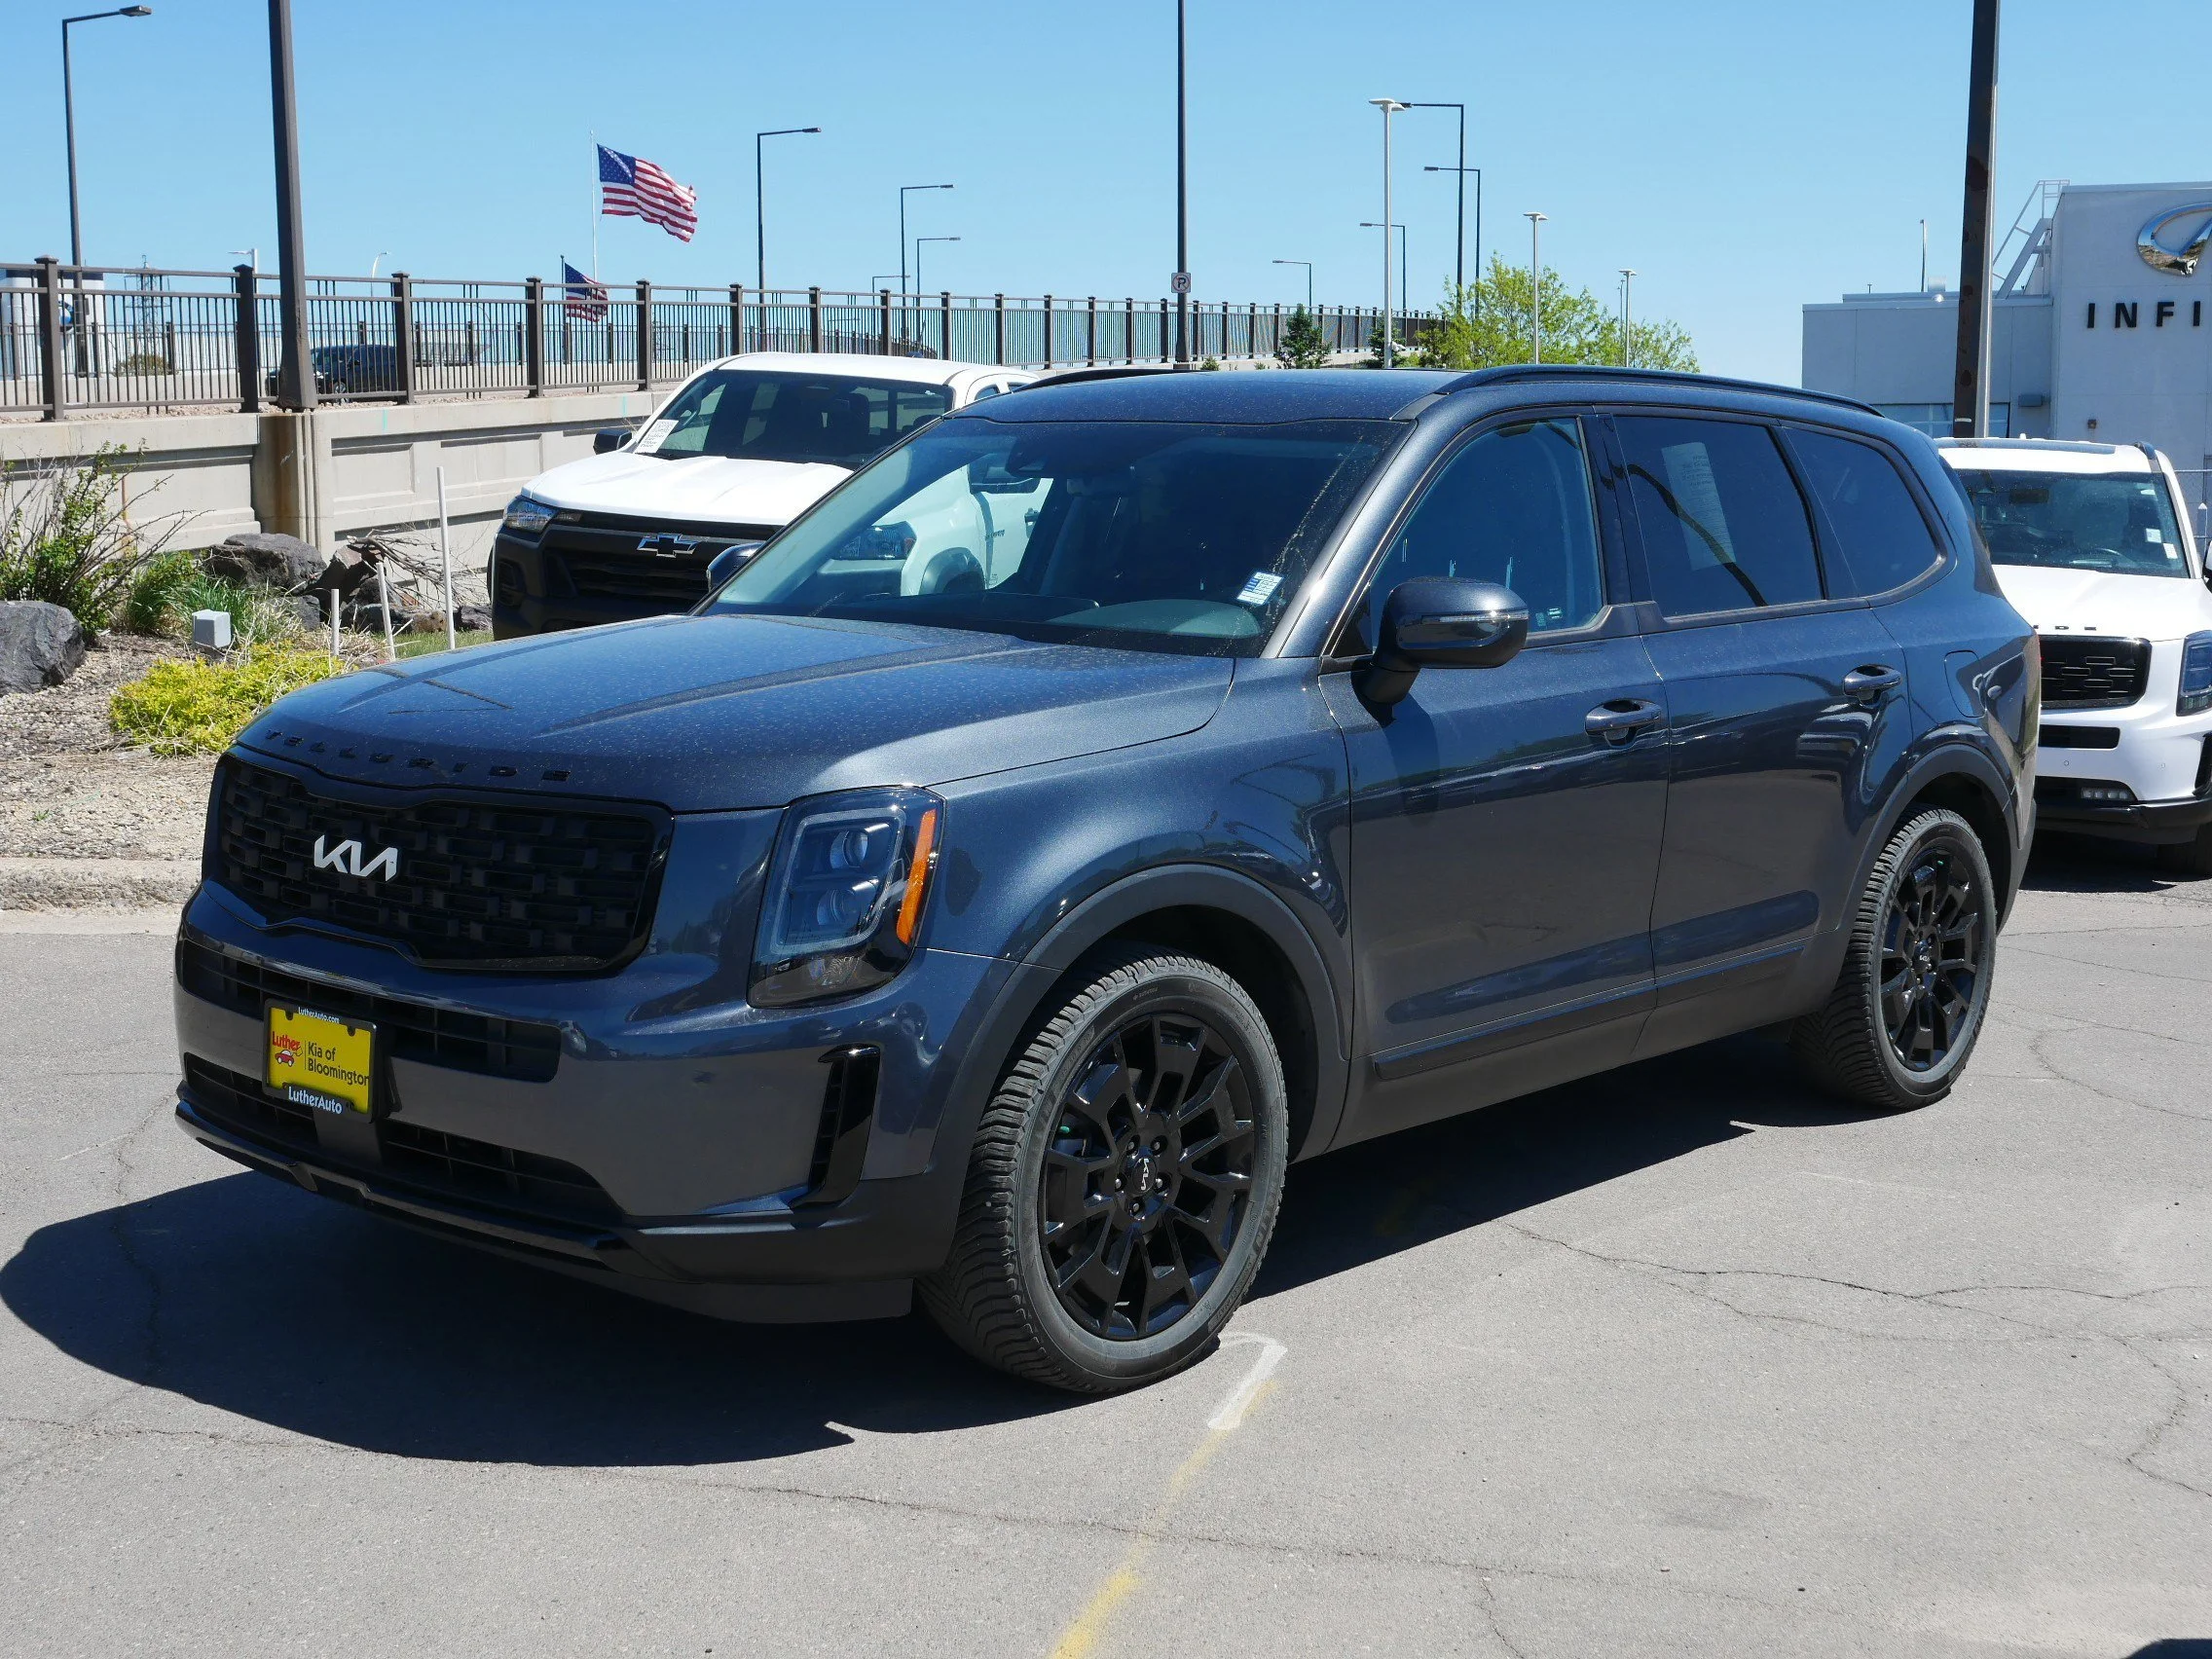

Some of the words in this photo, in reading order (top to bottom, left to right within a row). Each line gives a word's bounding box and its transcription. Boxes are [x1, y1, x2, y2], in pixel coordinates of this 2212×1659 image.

[2086, 300, 2201, 329] INFI
[313, 834, 399, 882] KIA
[298, 1006, 341, 1024] LutherAuto.com
[272, 1030, 301, 1051] Luther
[308, 1041, 323, 1058] Kia
[324, 1047, 337, 1062] of
[308, 1057, 370, 1087] Bloomington
[288, 1086, 343, 1115] LutherAuto
